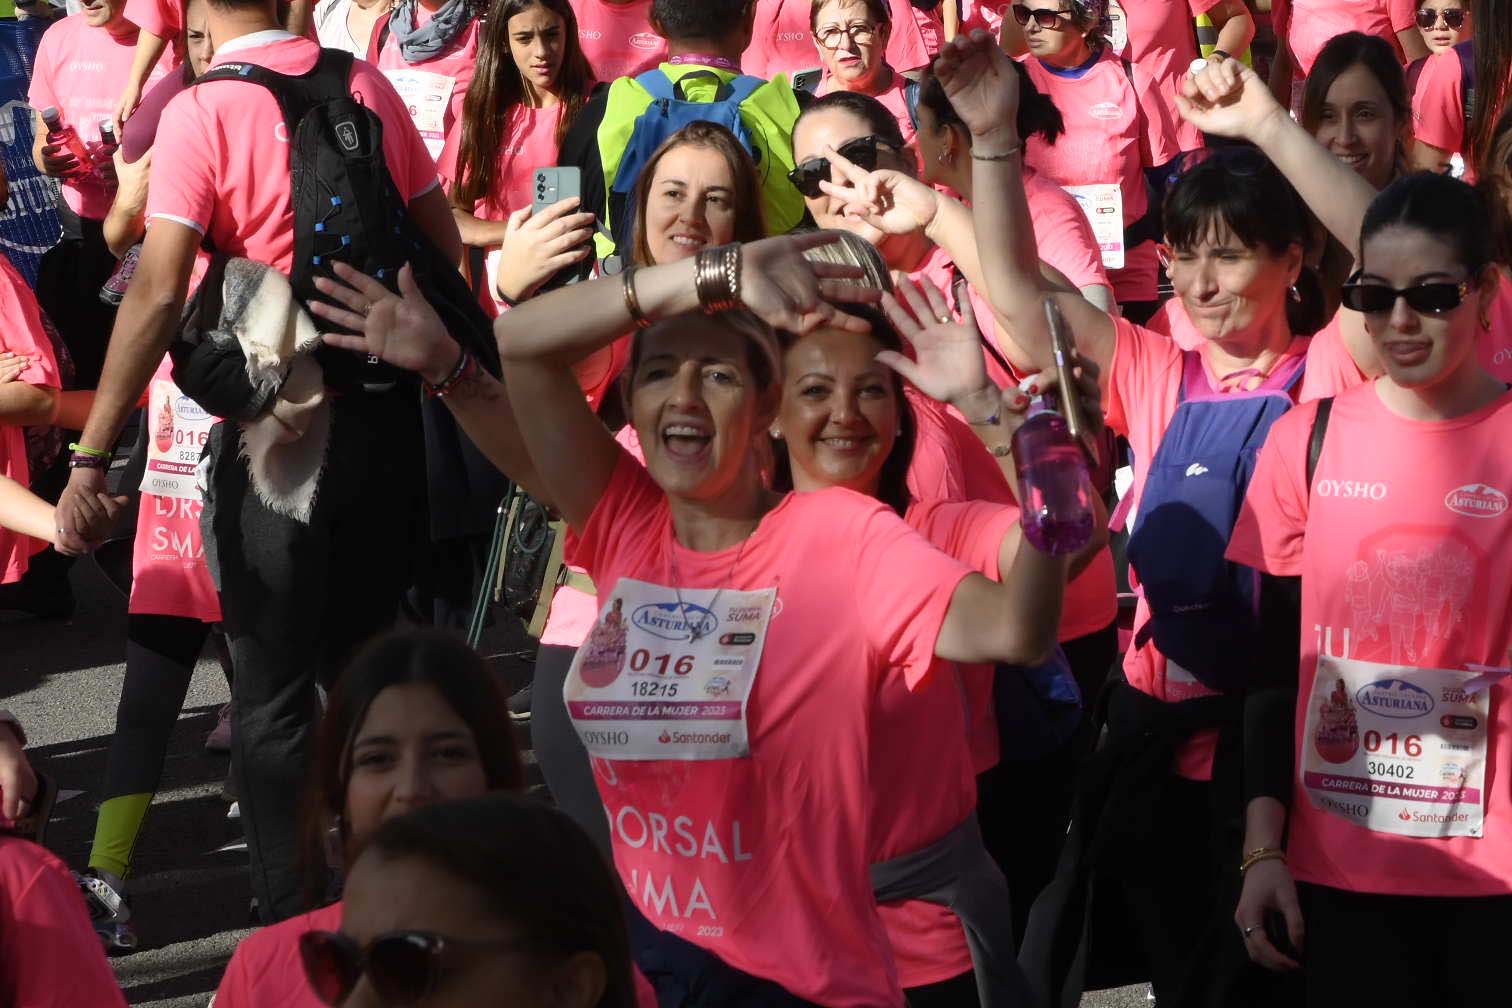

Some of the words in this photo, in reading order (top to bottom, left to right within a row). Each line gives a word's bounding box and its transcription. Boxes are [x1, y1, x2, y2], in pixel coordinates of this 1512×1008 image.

[176, 429, 209, 446] 016
[179, 464, 188, 473] DE
[1318, 479, 1387, 501] OYSHO
[1452, 497, 1504, 511] ASTURIANA
[726, 612, 761, 622] SUMA
[630, 649, 696, 676] 016
[631, 682, 678, 697] 18215
[1362, 691, 1429, 712] ASTURIANA
[1440, 692, 1477, 704] SUMA
[584, 705, 630, 716] CARRERA
[632, 705, 647, 716] DE
[647, 705, 660, 716] LA
[662, 705, 699, 715] MUJER
[701, 705, 727, 715] 2023
[585, 731, 629, 745] OYSHO
[673, 732, 732, 744] Santander
[1364, 730, 1423, 758] 016
[1368, 761, 1415, 779] 30402
[1322, 779, 1370, 792] CARRERA
[1371, 784, 1386, 793] DE
[1387, 786, 1401, 796] LA
[1403, 787, 1439, 799] MUJER
[1413, 811, 1470, 824] Santander
[632, 869, 717, 920] MA
